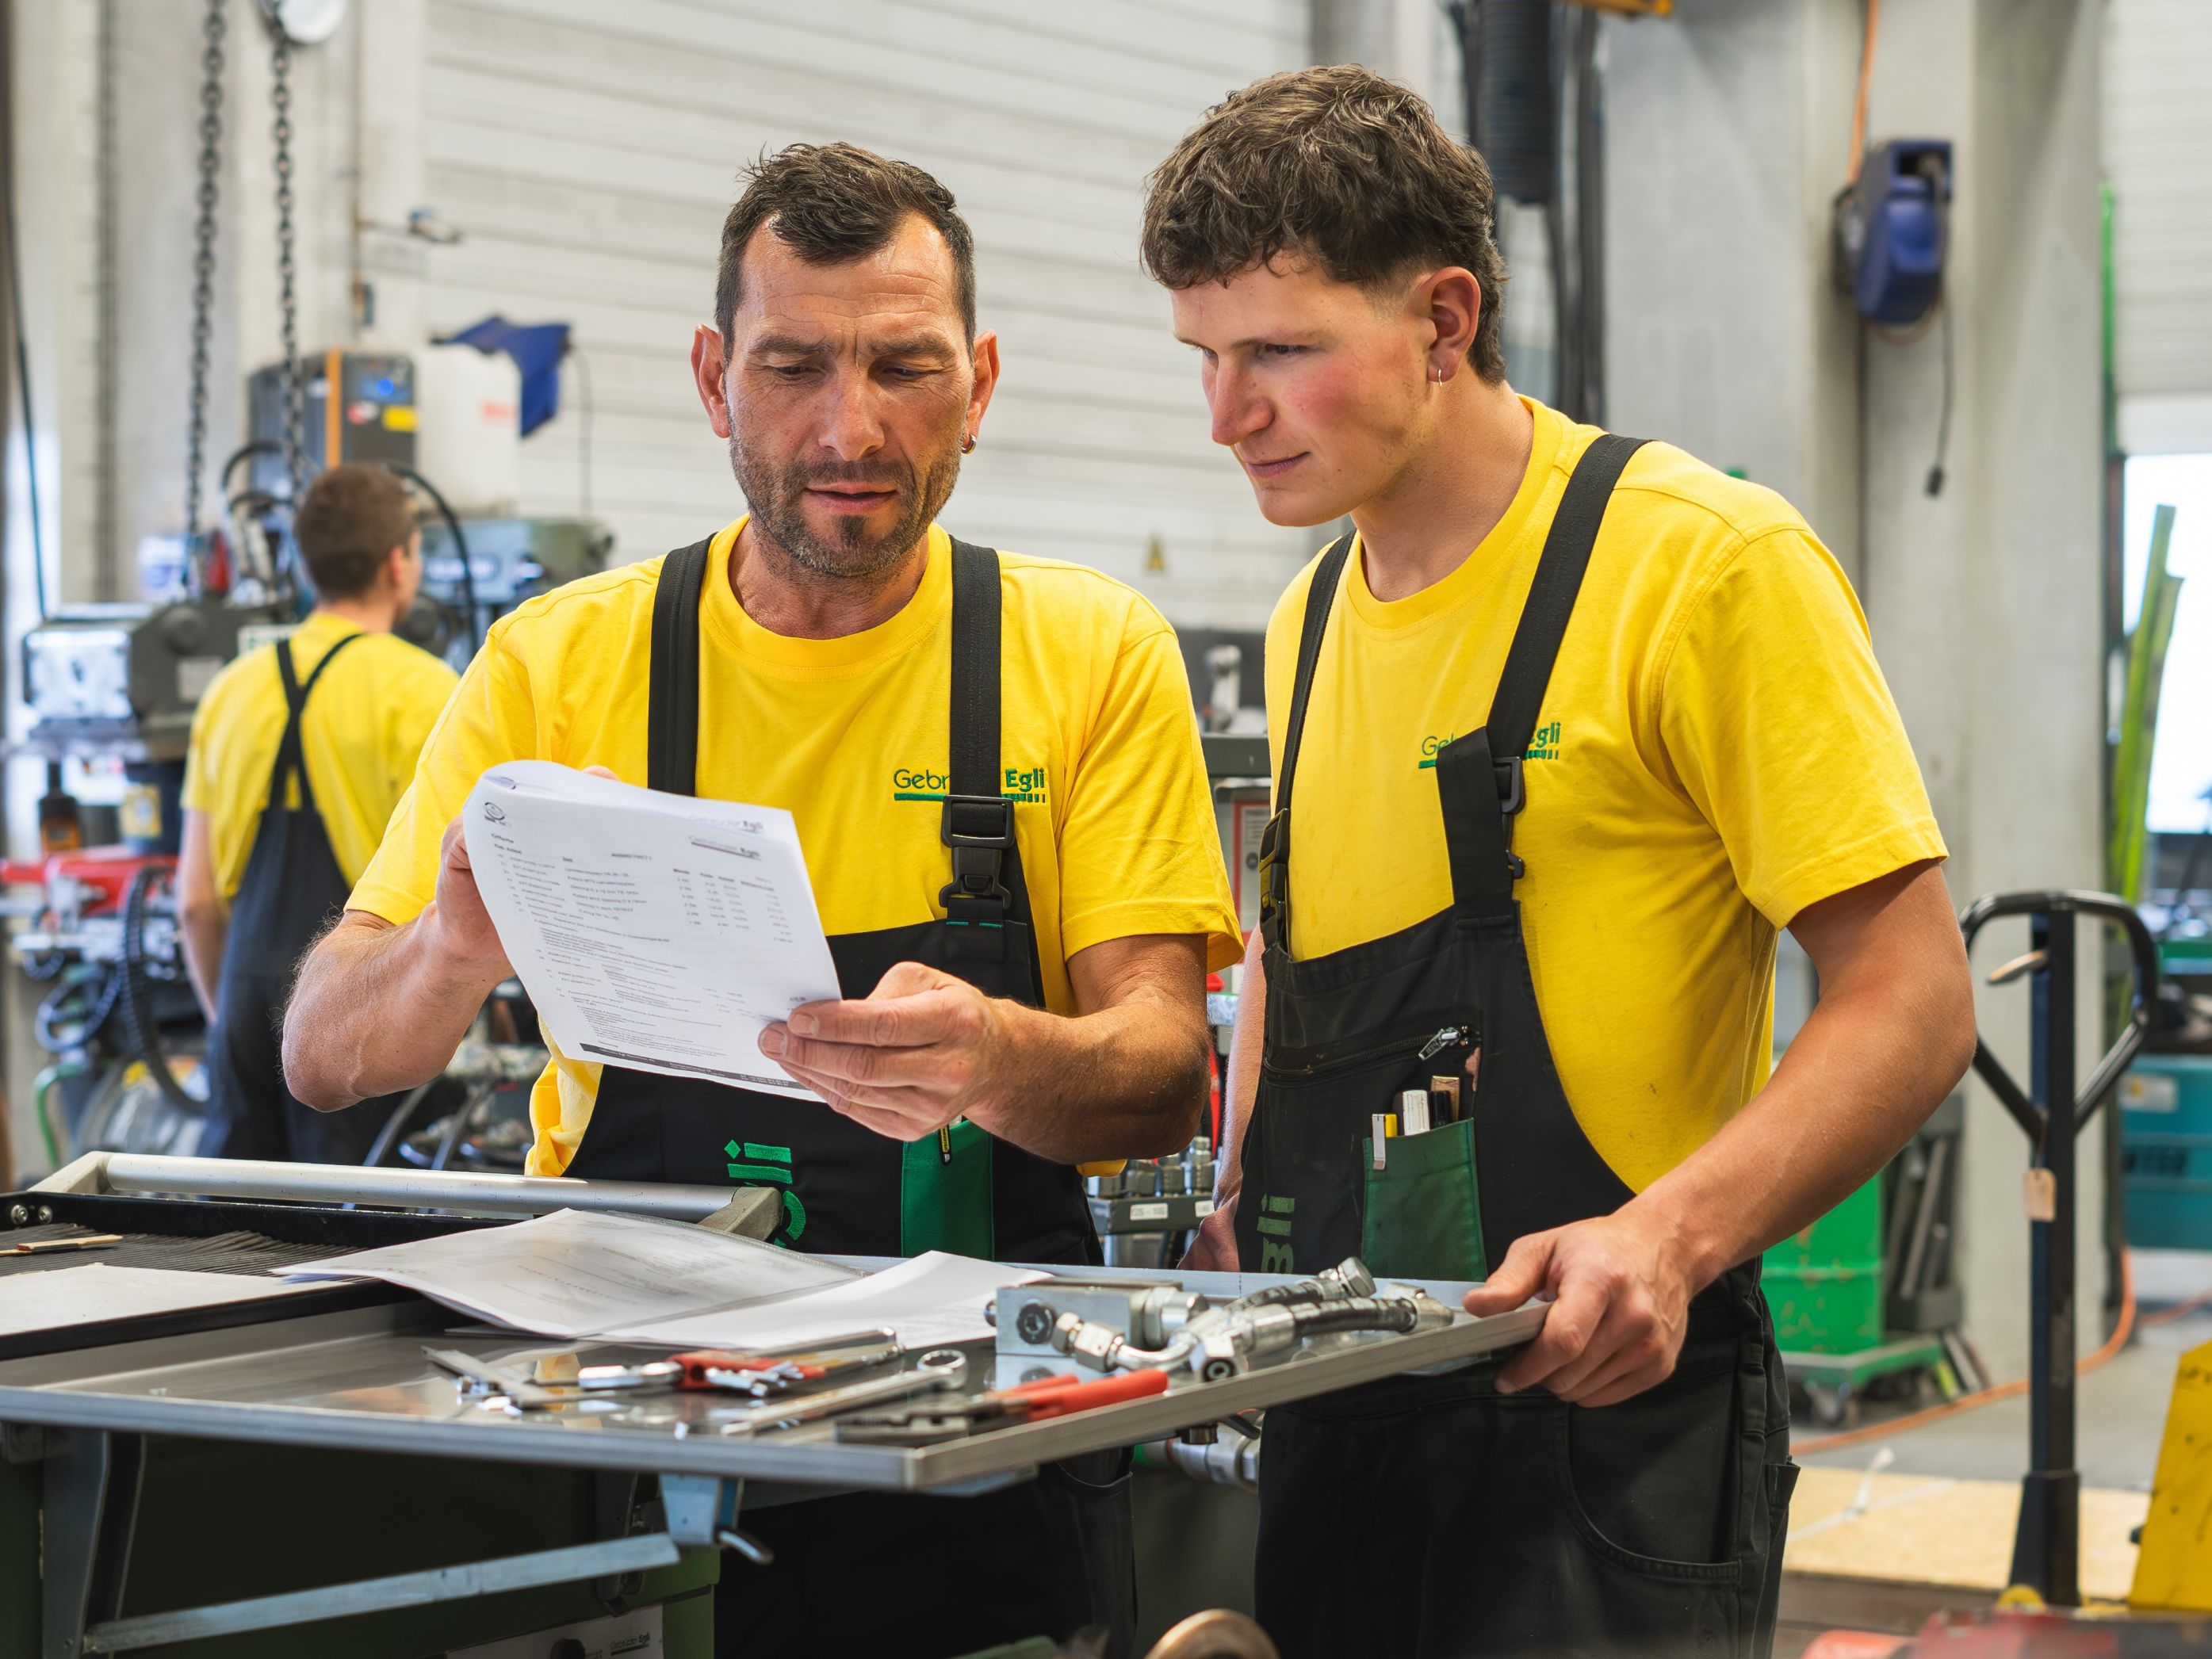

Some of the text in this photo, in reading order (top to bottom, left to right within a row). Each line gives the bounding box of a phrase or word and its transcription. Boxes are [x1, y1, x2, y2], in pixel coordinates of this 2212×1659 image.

[1530, 722, 1559, 748] gli
[893, 766, 1045, 792] Gebr Egli
